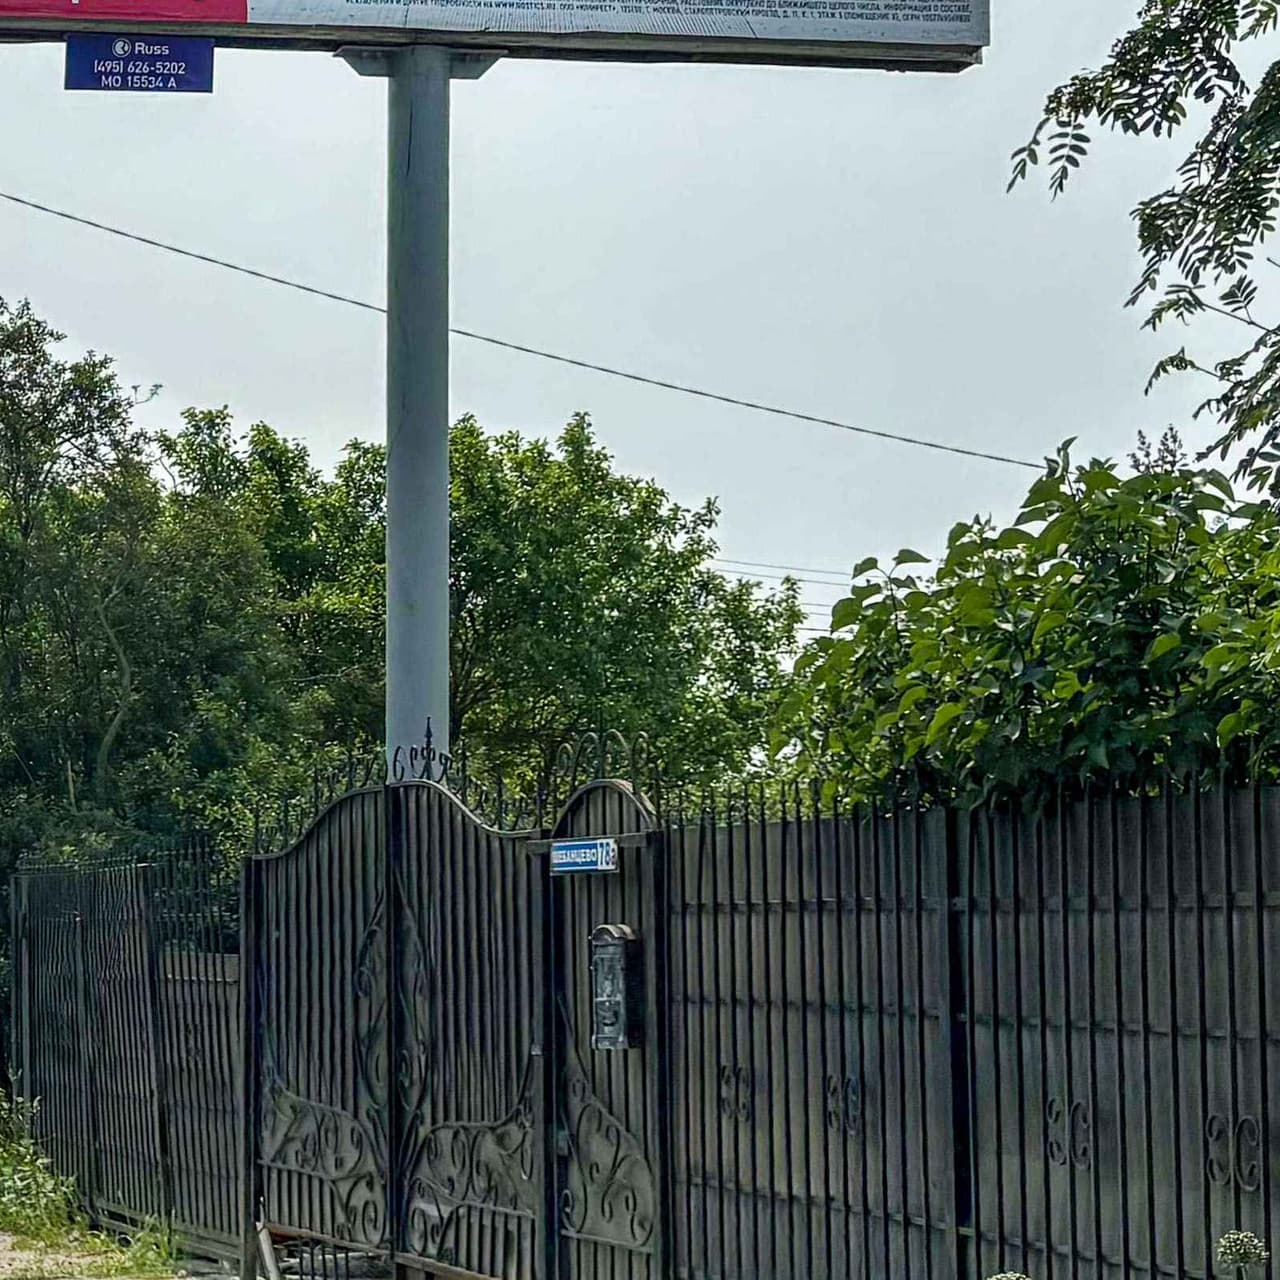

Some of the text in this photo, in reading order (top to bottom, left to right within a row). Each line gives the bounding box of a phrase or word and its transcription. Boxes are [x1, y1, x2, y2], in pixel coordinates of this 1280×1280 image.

[135, 43, 170, 55] Russ
[94, 60, 186, 74] (495) 626-5202
[127, 77, 163, 88] 15534
